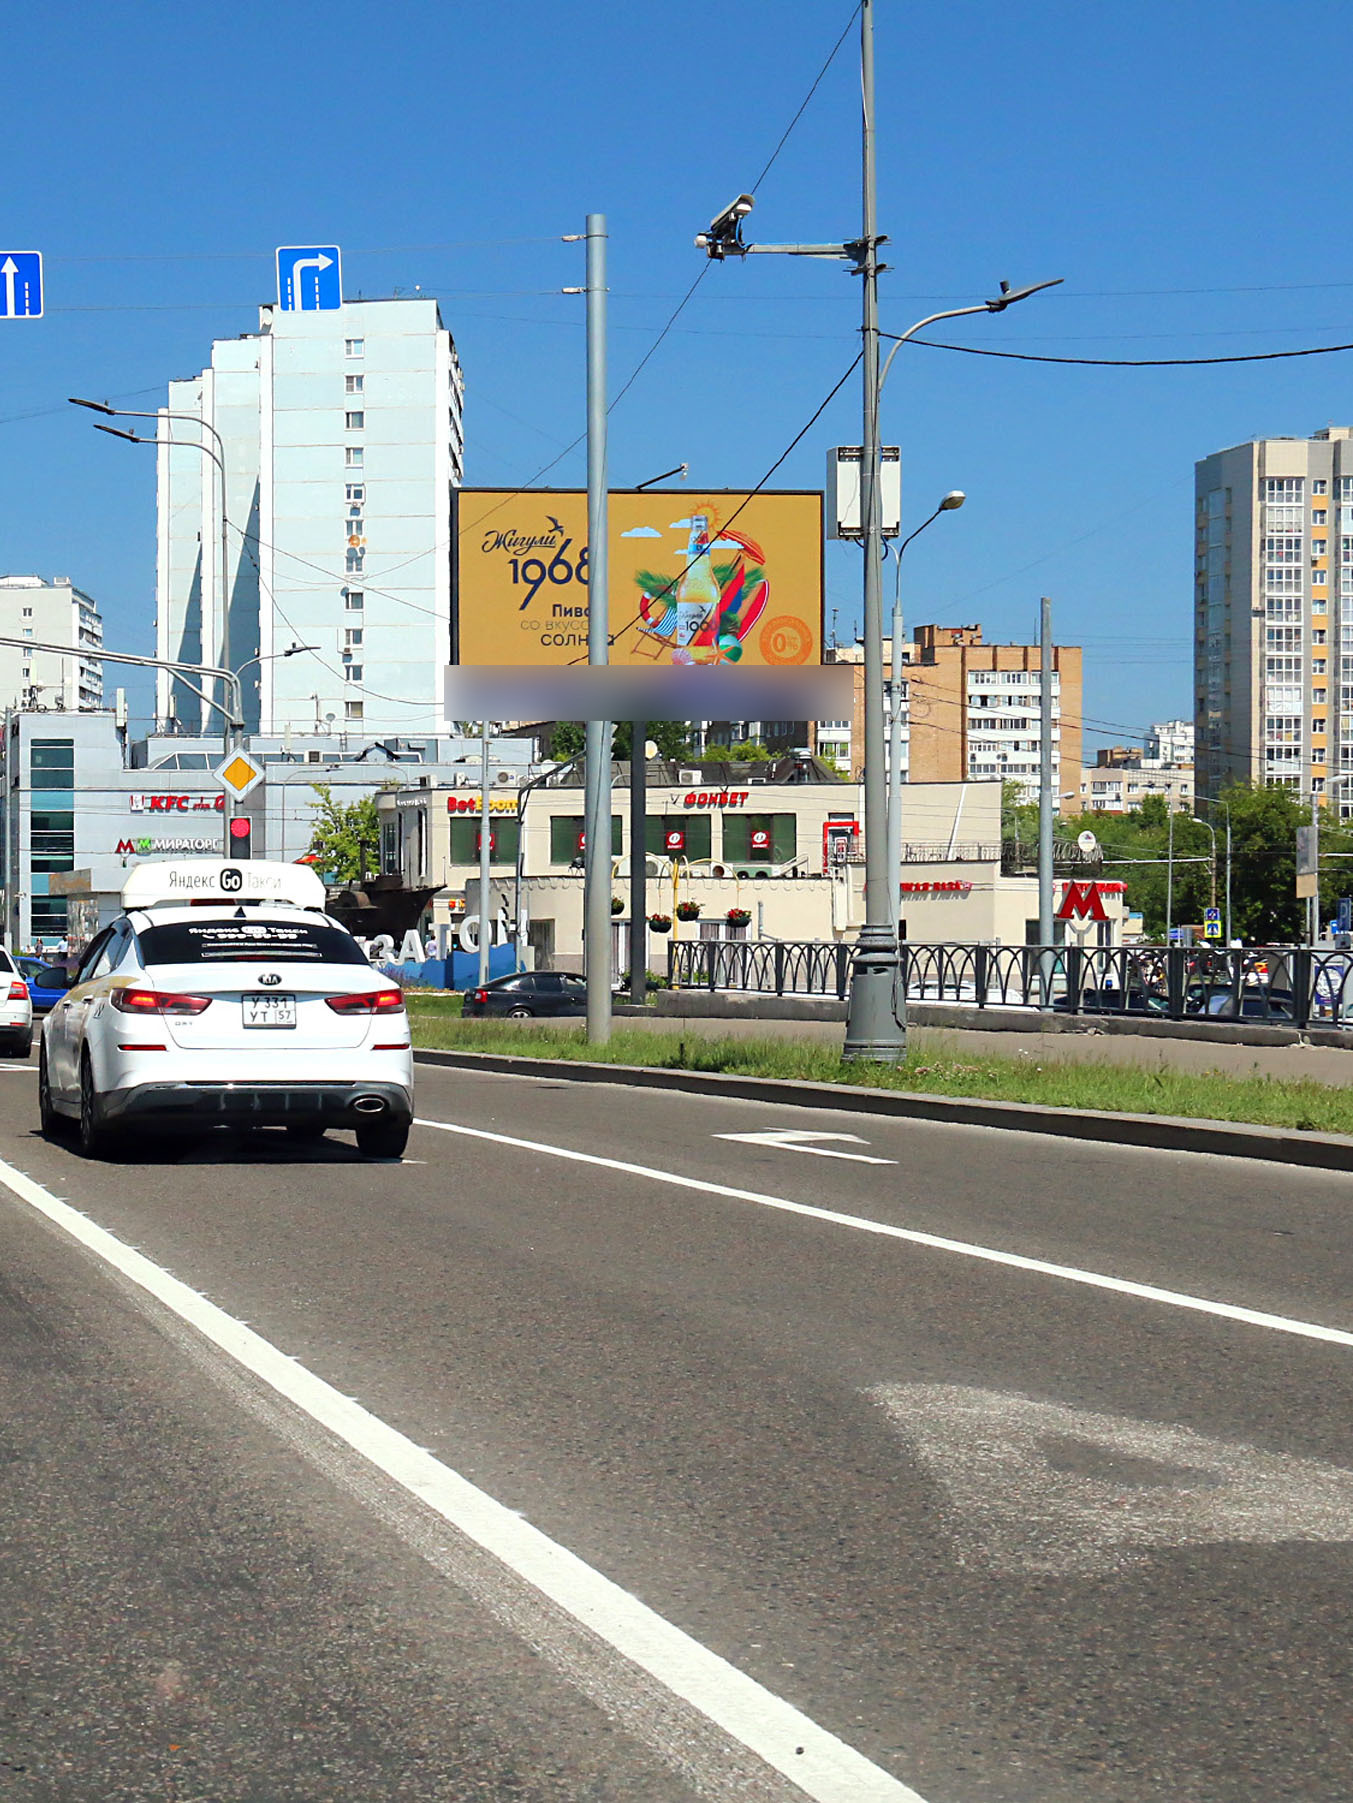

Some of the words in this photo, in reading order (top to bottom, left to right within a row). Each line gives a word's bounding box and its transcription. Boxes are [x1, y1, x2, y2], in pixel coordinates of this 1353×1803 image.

[481, 529, 556, 556] Жигули
[520, 620, 540, 630] со
[540, 634, 614, 646] солна
[150, 795, 191, 810] KFC
[153, 838, 219, 850] МИРАТОРГ
[169, 871, 215, 889] Яндекс
[221, 870, 241, 890] Go
[1056, 878, 1109, 921] М
